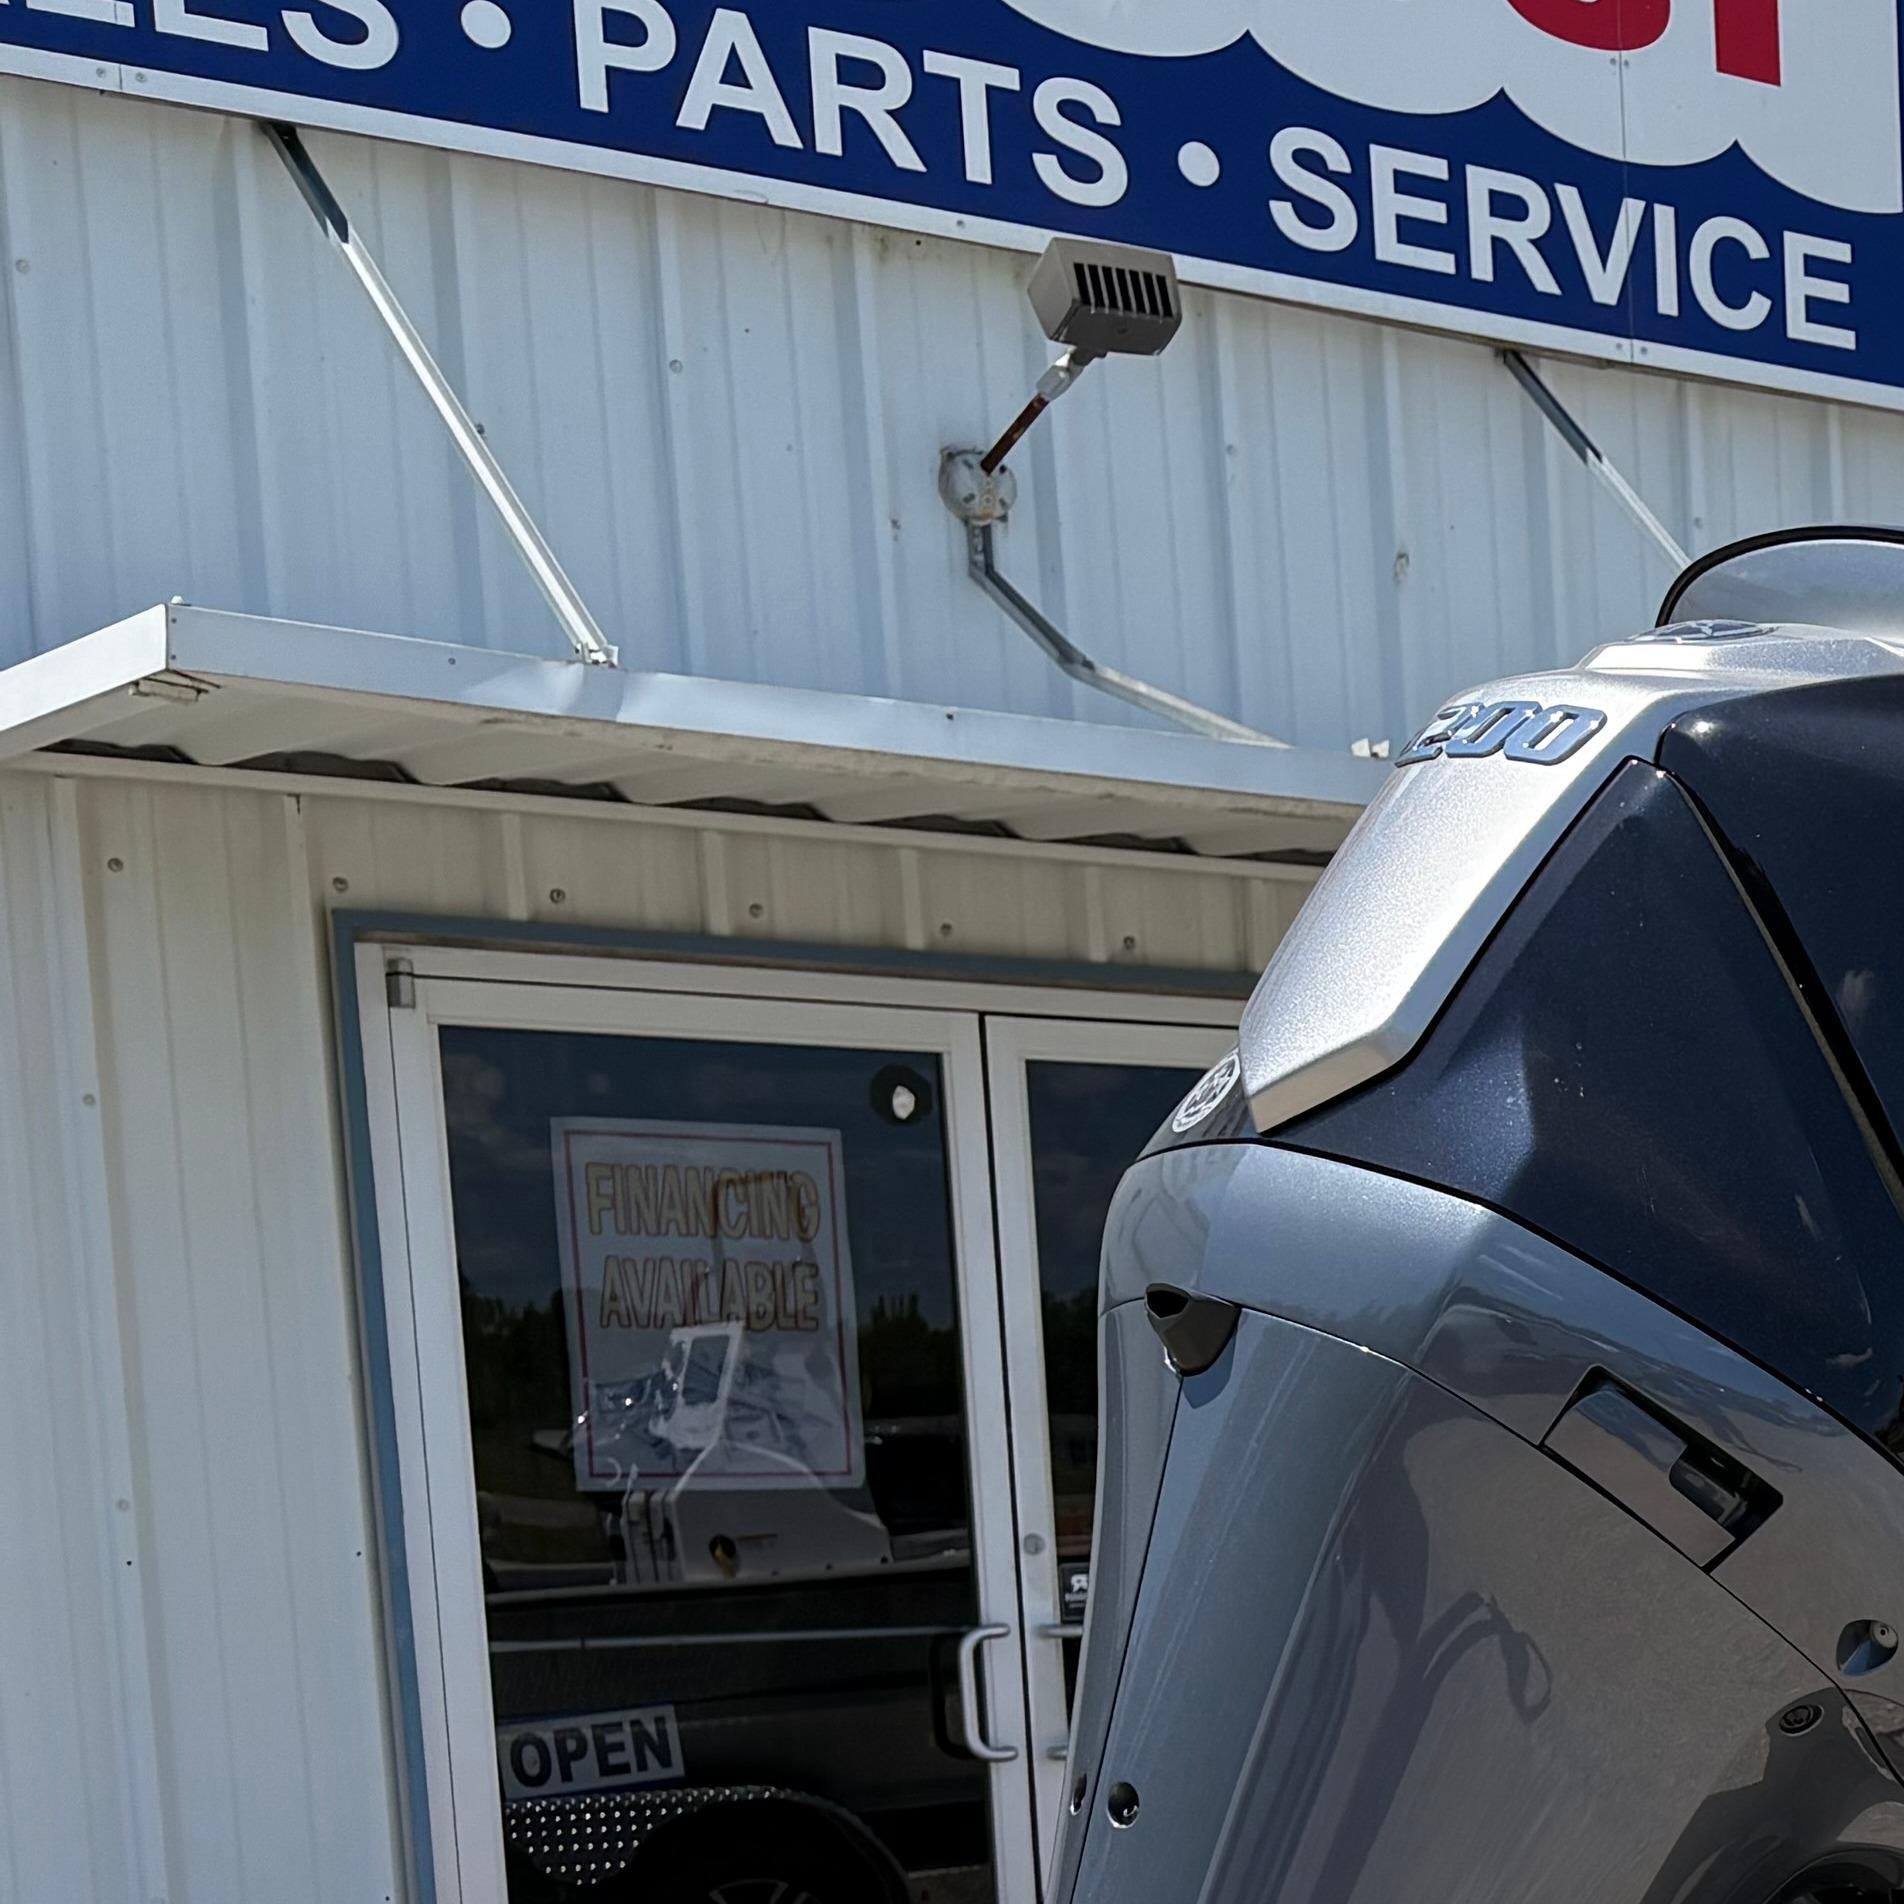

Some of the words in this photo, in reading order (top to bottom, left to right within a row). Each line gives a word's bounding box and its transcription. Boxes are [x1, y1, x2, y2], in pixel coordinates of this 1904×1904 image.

[571, 0, 1129, 206] PARTS
[1268, 126, 1857, 351] SERVICE
[1395, 700, 1608, 767] 200
[585, 1161, 821, 1243] FINANCING
[600, 1254, 820, 1332] AVAILABLE
[510, 1716, 673, 1788] OPEN
